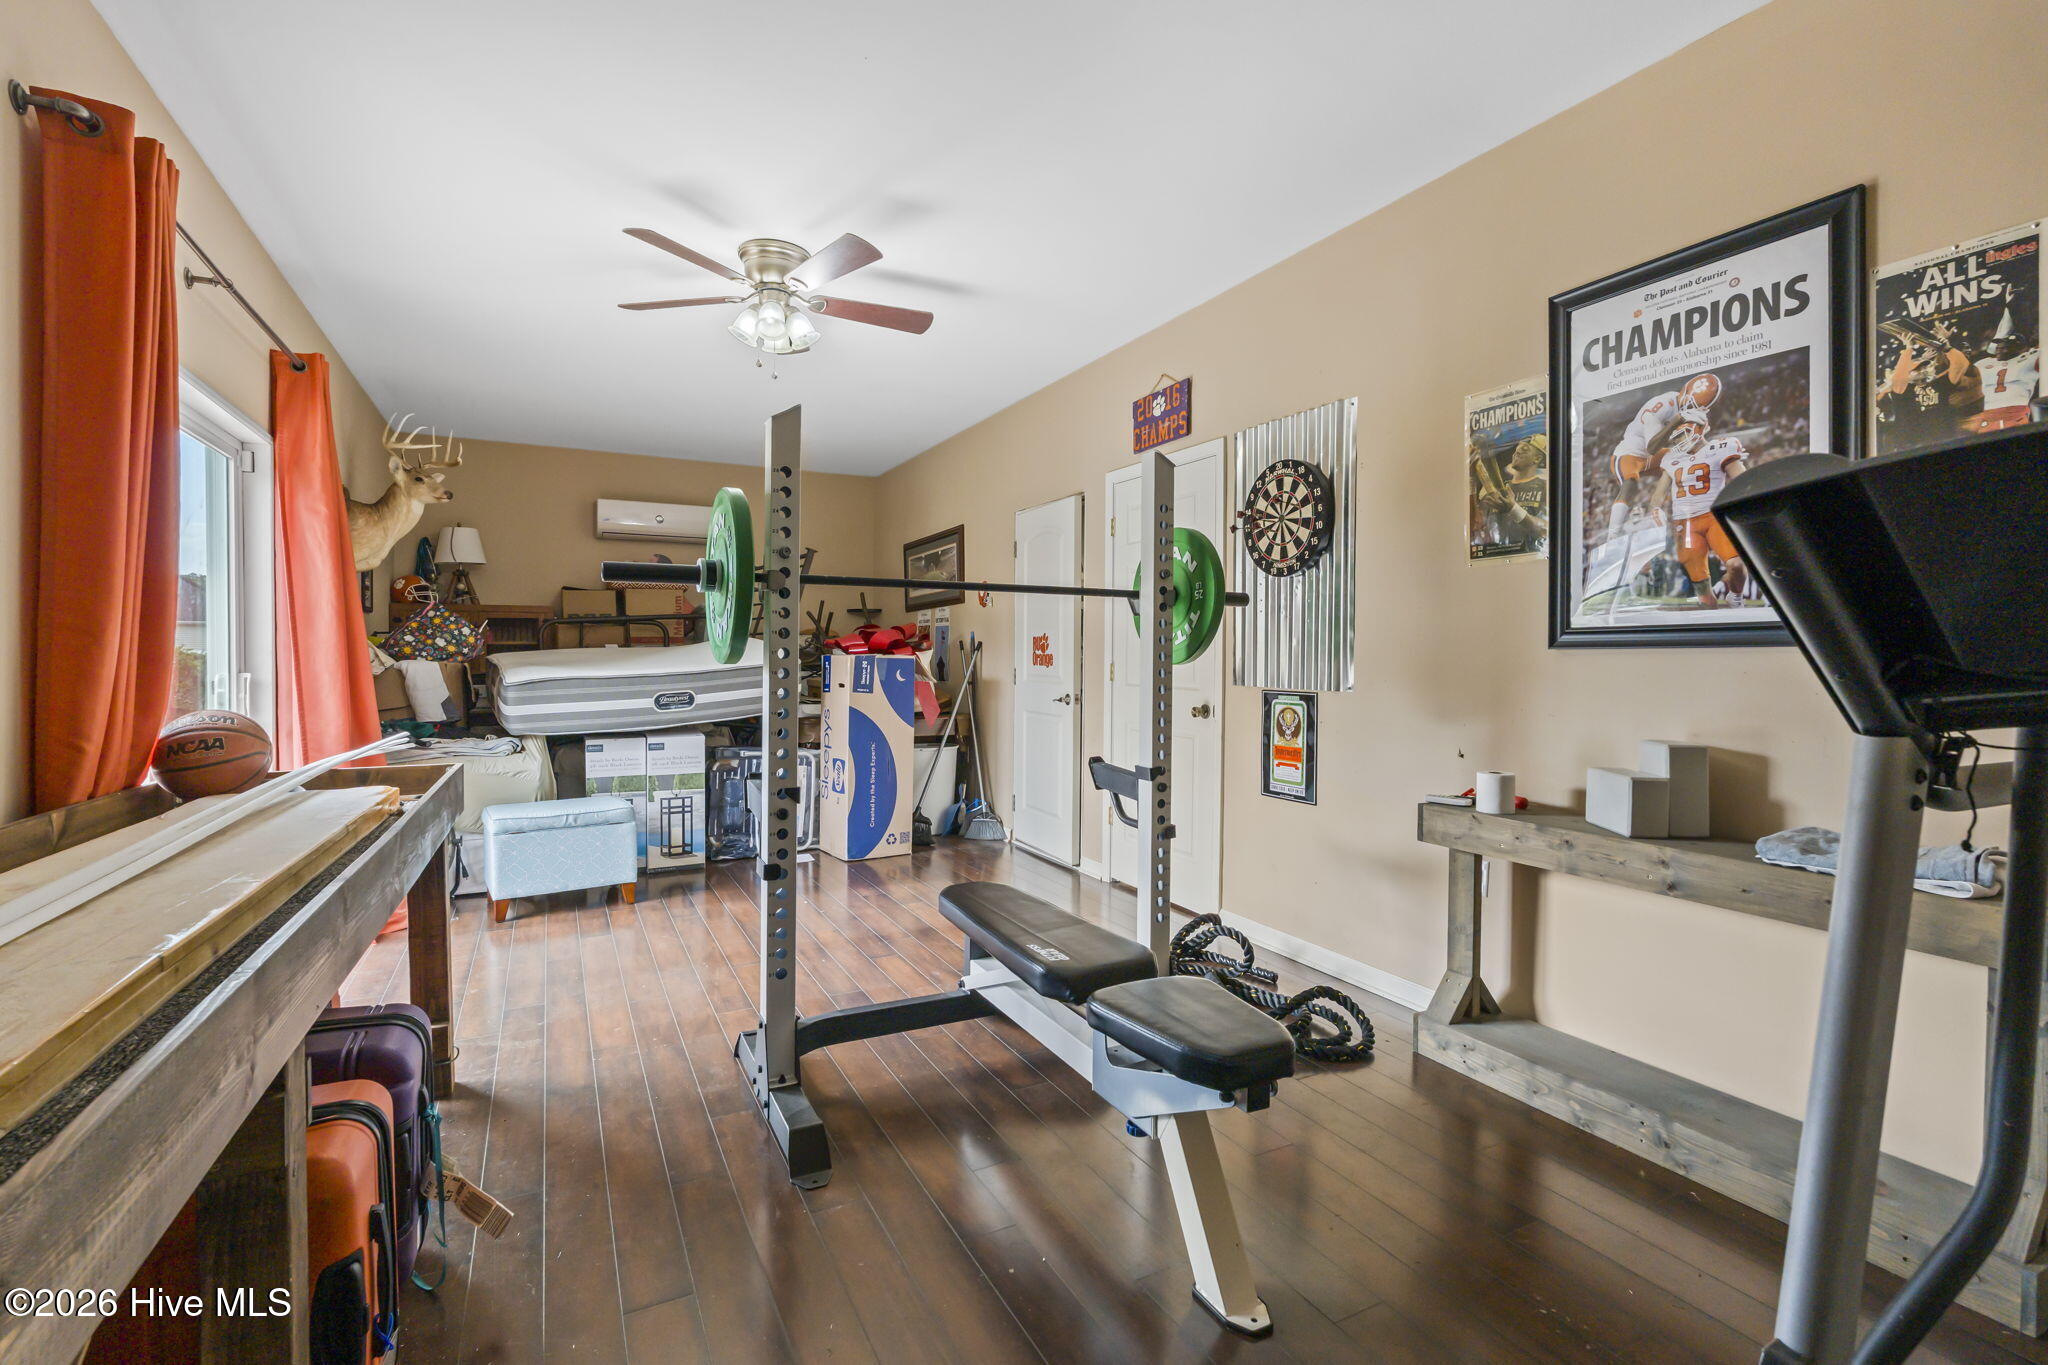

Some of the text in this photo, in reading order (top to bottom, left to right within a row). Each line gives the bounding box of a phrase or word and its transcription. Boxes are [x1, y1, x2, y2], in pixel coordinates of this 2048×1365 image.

[1950, 240, 1995, 257] CHAMPIONS
[1985, 241, 2038, 264] ingles
[1643, 293, 1658, 301] The
[1660, 286, 1677, 298] Post
[1678, 280, 1693, 291] and
[1695, 269, 1728, 285] Courier
[1919, 255, 1987, 292] ALL
[1906, 274, 2003, 318] WINS
[1582, 273, 1811, 373] CHAMPIONS
[1607, 340, 1772, 391] first national championship since 1981
[1613, 331, 1764, 379] Clemson defeats Alabama to claim
[1994, 368, 2008, 393] 1
[1471, 395, 1545, 431] CHAMPIONS
[1133, 410, 1188, 451] CHAMPS
[1276, 461, 1283, 470] 20
[1298, 465, 1306, 475] 18
[1308, 474, 1313, 483] 4
[1674, 462, 1711, 498] 13
[1313, 487, 1321, 496] 13
[1317, 503, 1323, 512] 6
[1315, 521, 1323, 529] 10
[1310, 537, 1318, 545] 15
[1304, 550, 1309, 559] 2
[673, 596, 682, 636] Meium
[166, 737, 225, 758] NCAA
[869, 767, 877, 784] Sleep
